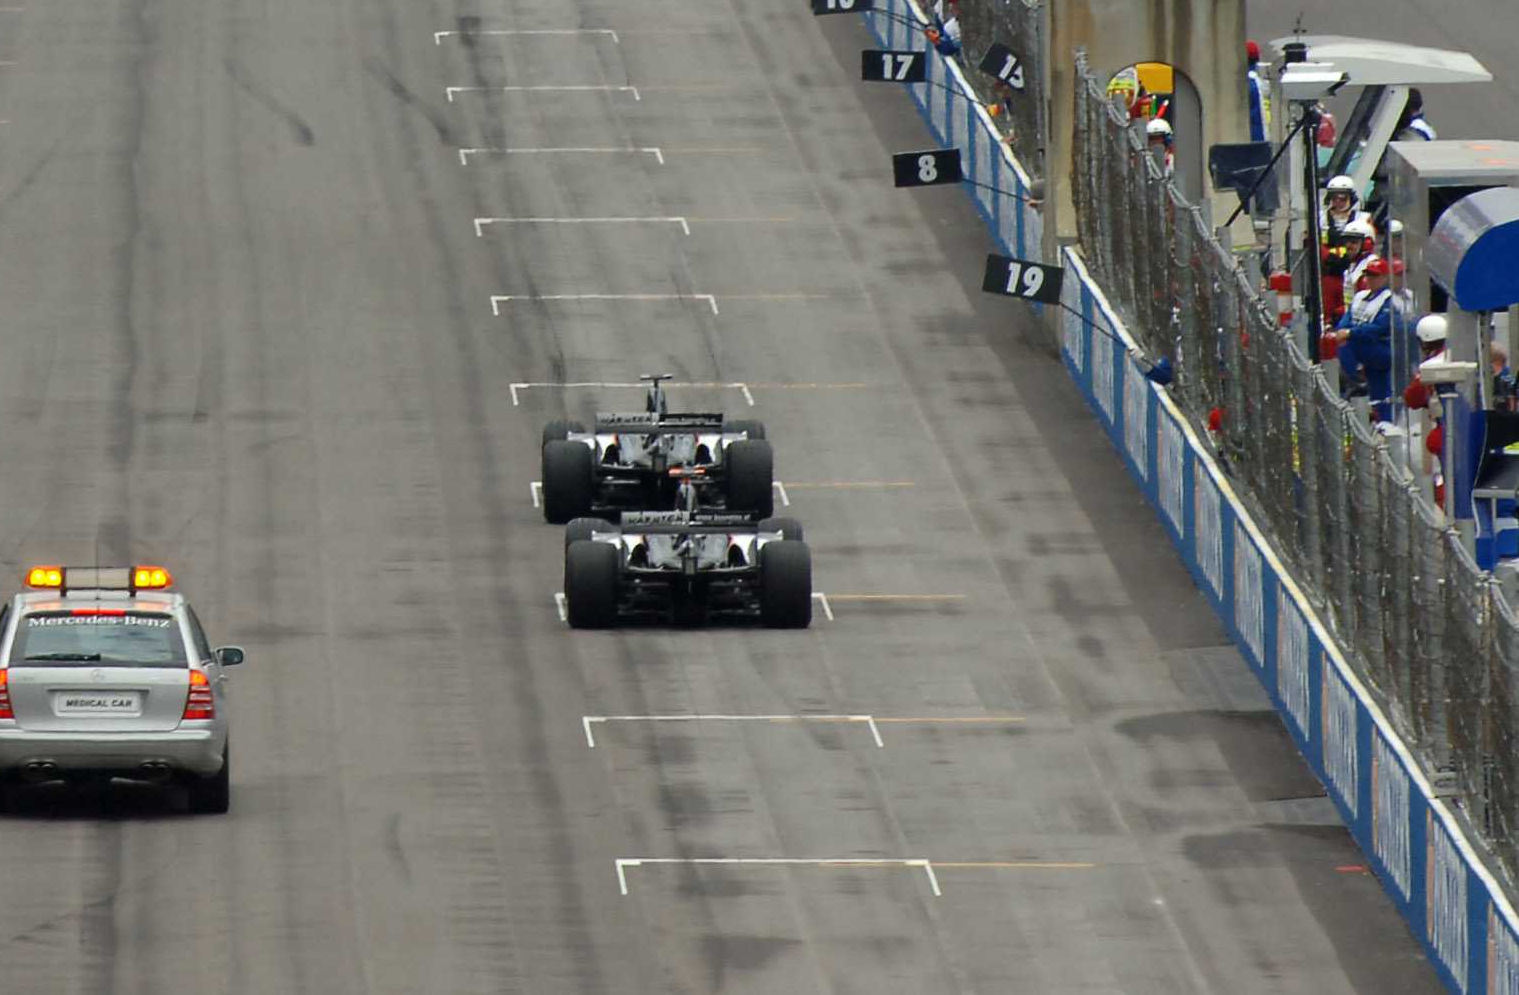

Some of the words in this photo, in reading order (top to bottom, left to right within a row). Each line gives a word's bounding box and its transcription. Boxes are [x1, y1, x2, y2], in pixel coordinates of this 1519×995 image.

[882, 54, 915, 80] 17
[918, 154, 938, 183] 8
[1005, 261, 1045, 297] 19
[28, 615, 171, 628] Mercedes-Benz
[65, 699, 108, 708] MEDICAL
[111, 698, 134, 708] CAR
